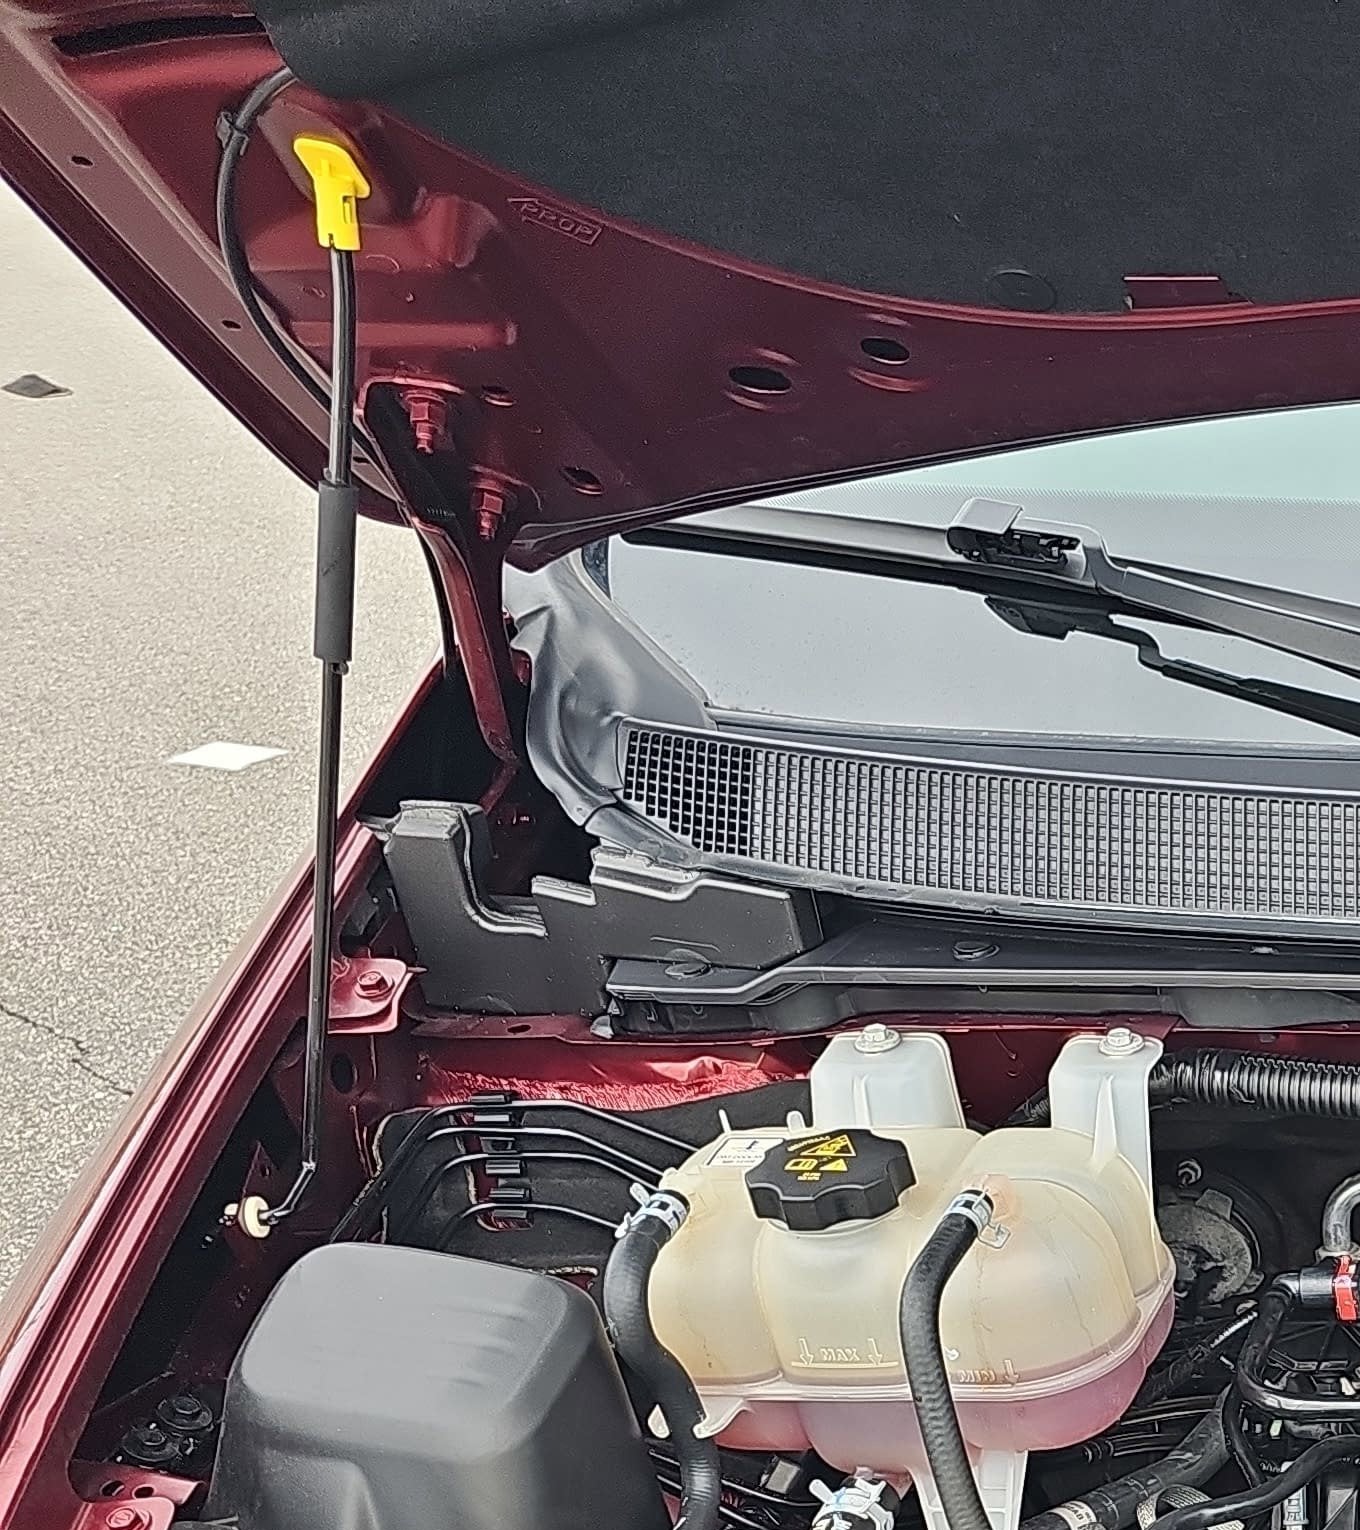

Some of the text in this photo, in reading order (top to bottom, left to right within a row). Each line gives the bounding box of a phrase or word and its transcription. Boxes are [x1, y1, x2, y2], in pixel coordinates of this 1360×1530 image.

[521, 200, 597, 242] PROP
[820, 1348, 860, 1362] MAX
[958, 1368, 997, 1384] MIN
